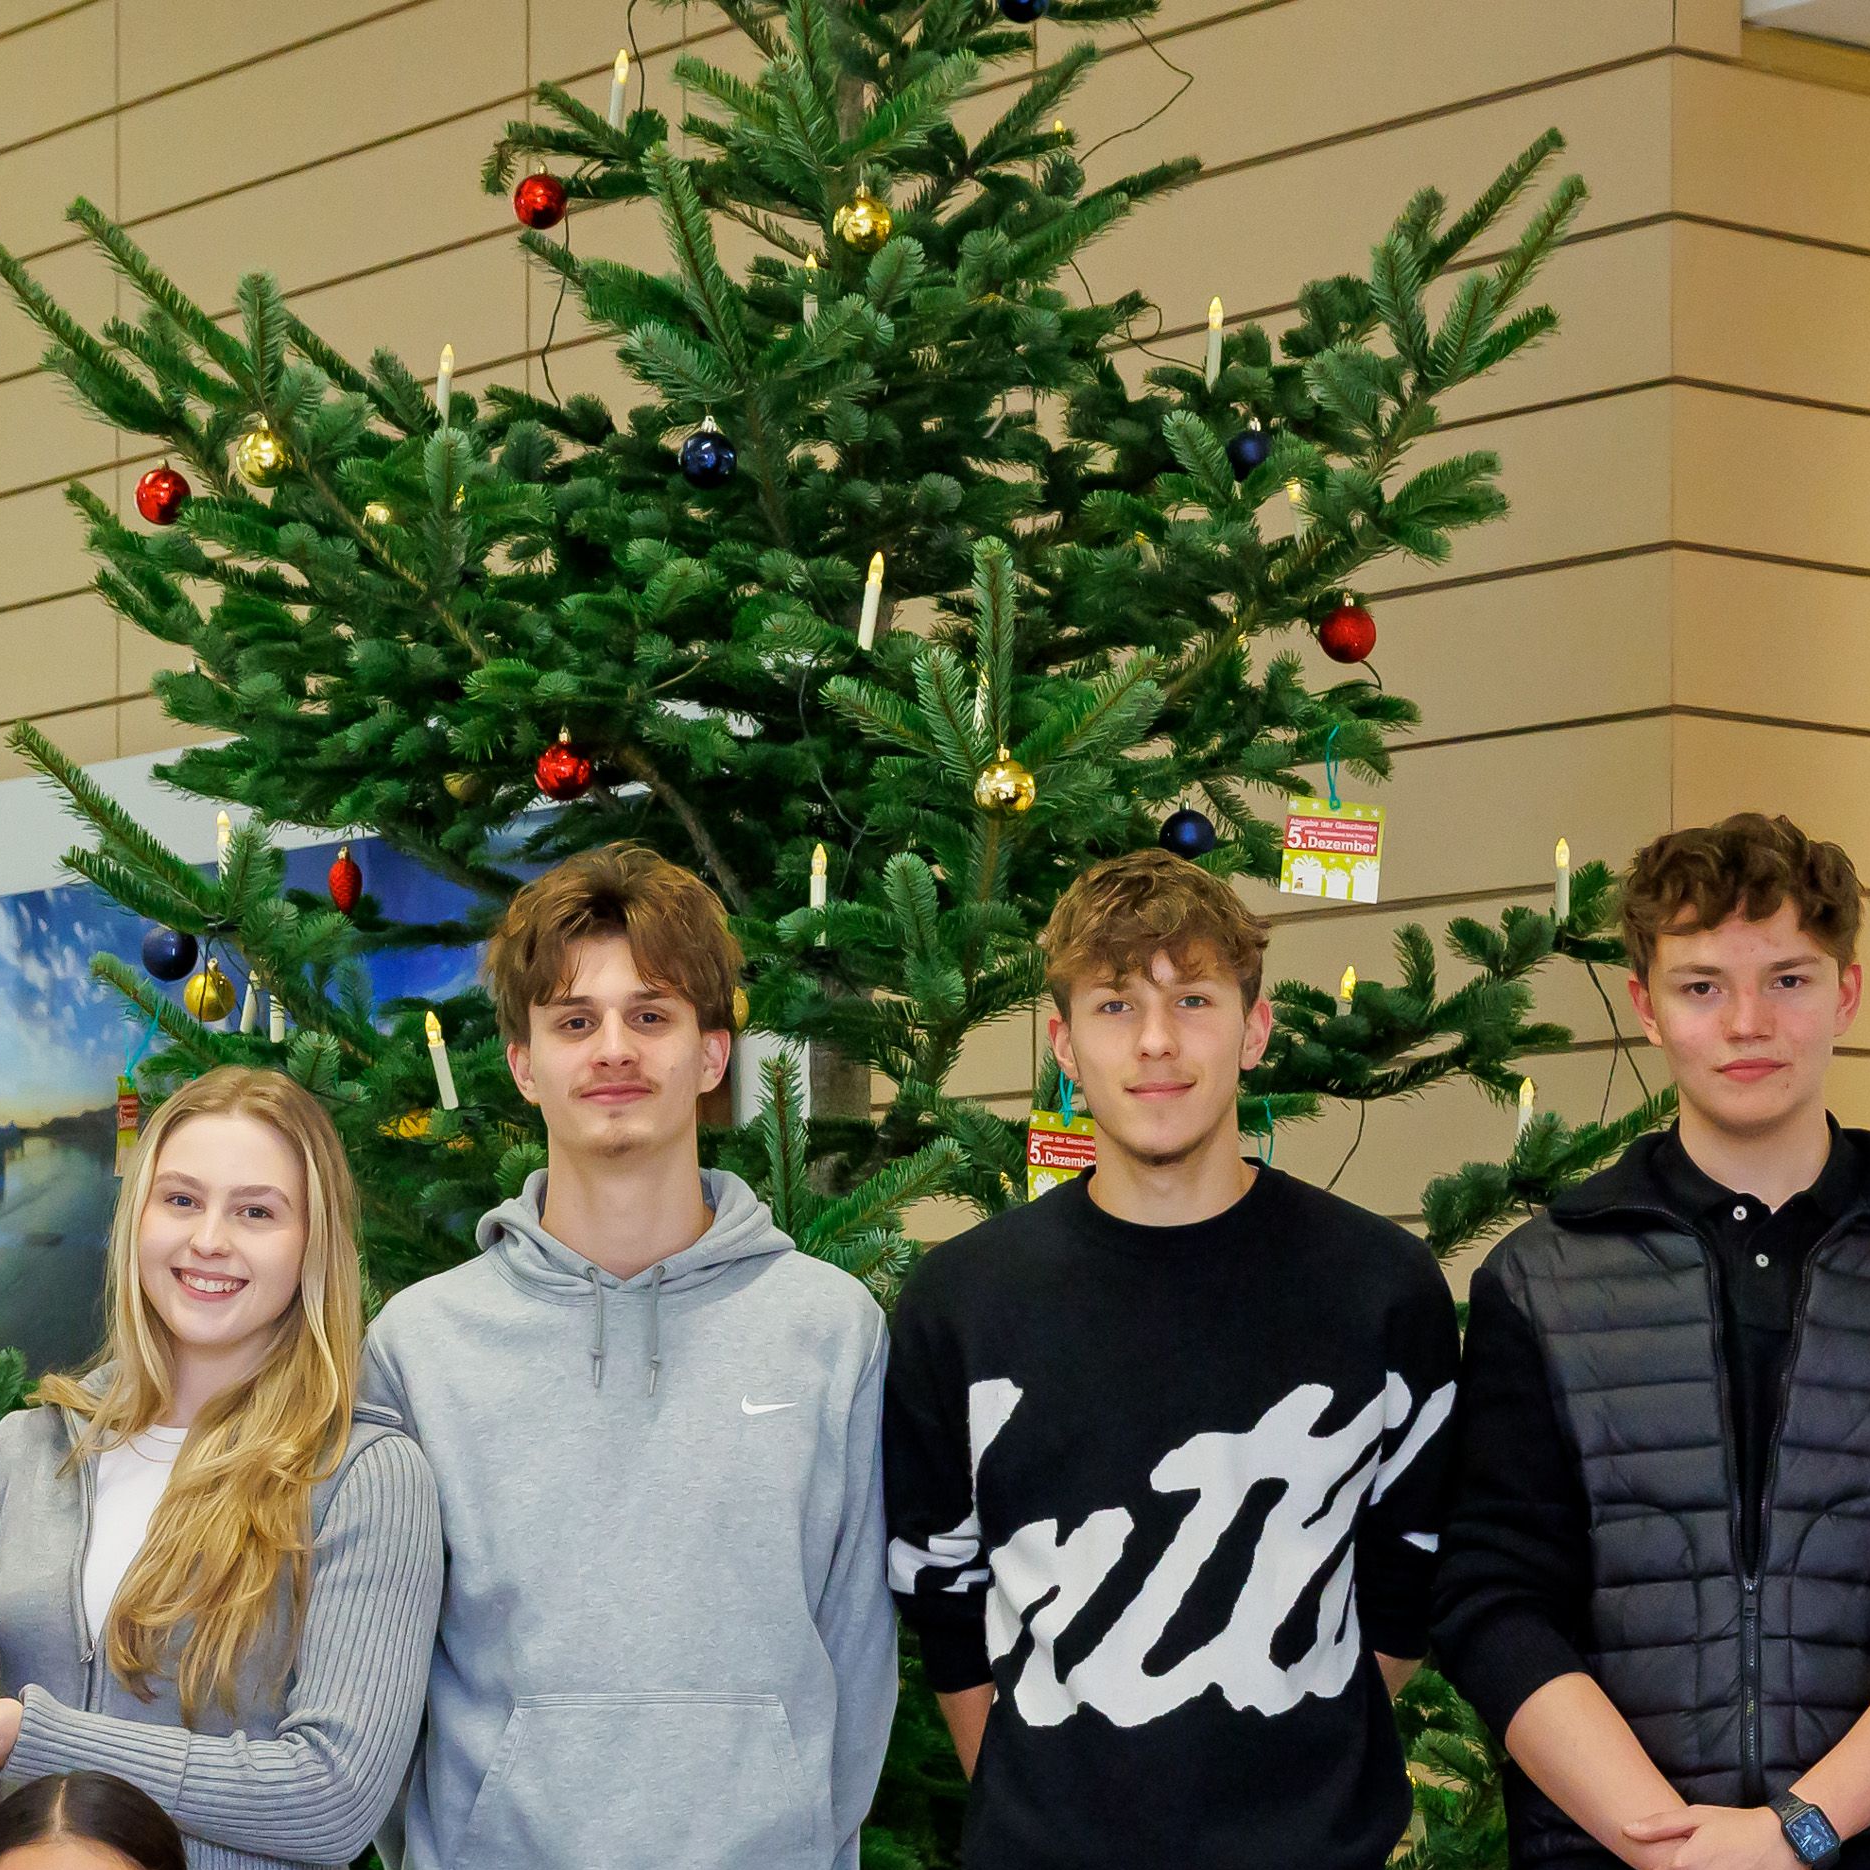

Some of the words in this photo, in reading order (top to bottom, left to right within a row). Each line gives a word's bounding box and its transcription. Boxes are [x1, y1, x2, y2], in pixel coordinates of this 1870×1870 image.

[1287, 827, 1307, 849] 5.
[1308, 836, 1377, 853] Dezember
[1030, 1141, 1045, 1164] 5.
